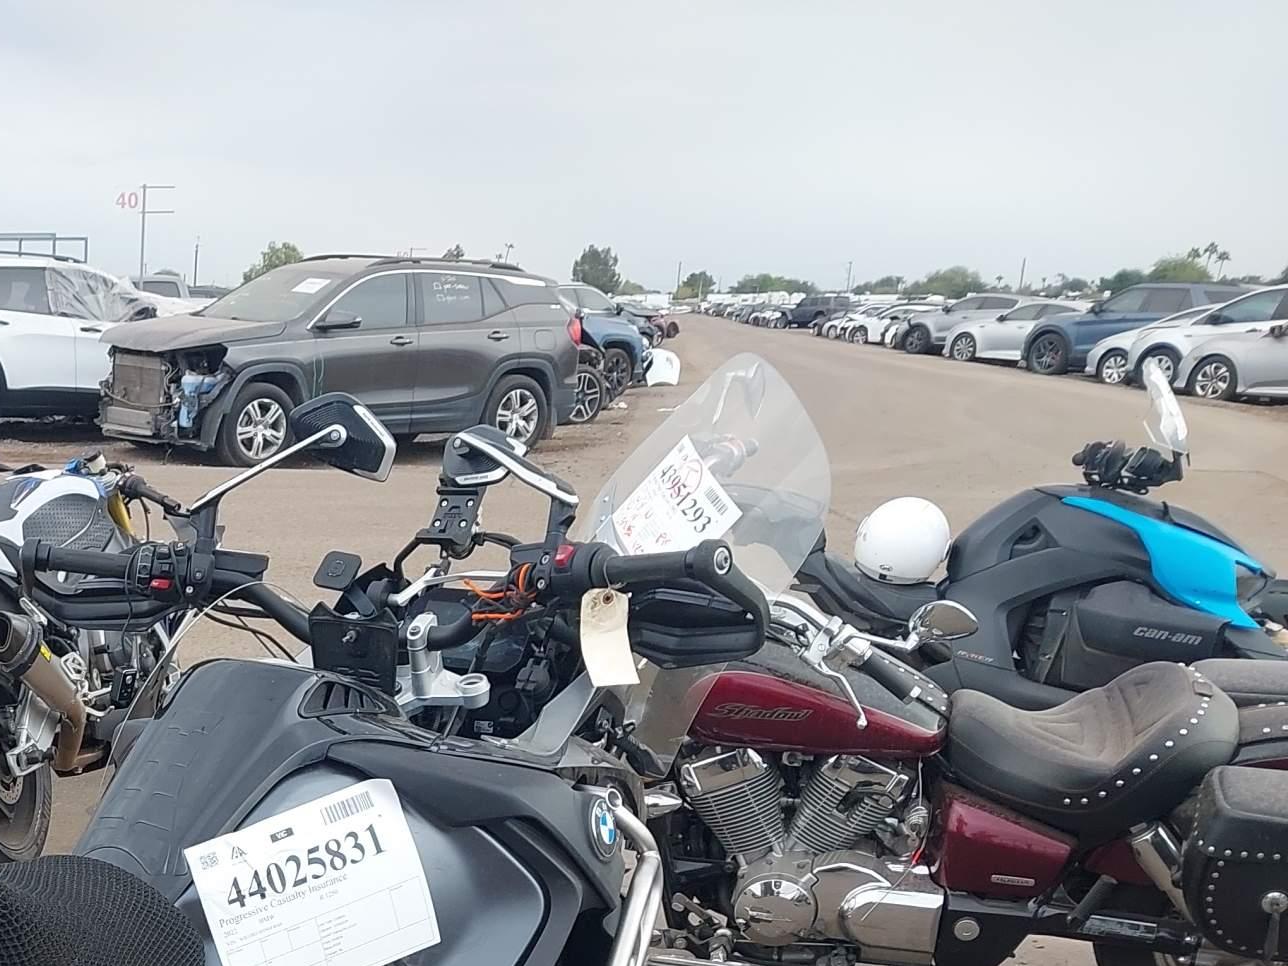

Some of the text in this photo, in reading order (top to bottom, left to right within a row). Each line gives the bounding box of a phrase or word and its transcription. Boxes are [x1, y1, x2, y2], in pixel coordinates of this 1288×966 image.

[115, 191, 138, 209] 40
[660, 464, 712, 533] 43951293
[714, 703, 814, 722] Shadow
[227, 823, 388, 908] 44025831
[219, 873, 348, 929] Progressive Casualty Insurance
